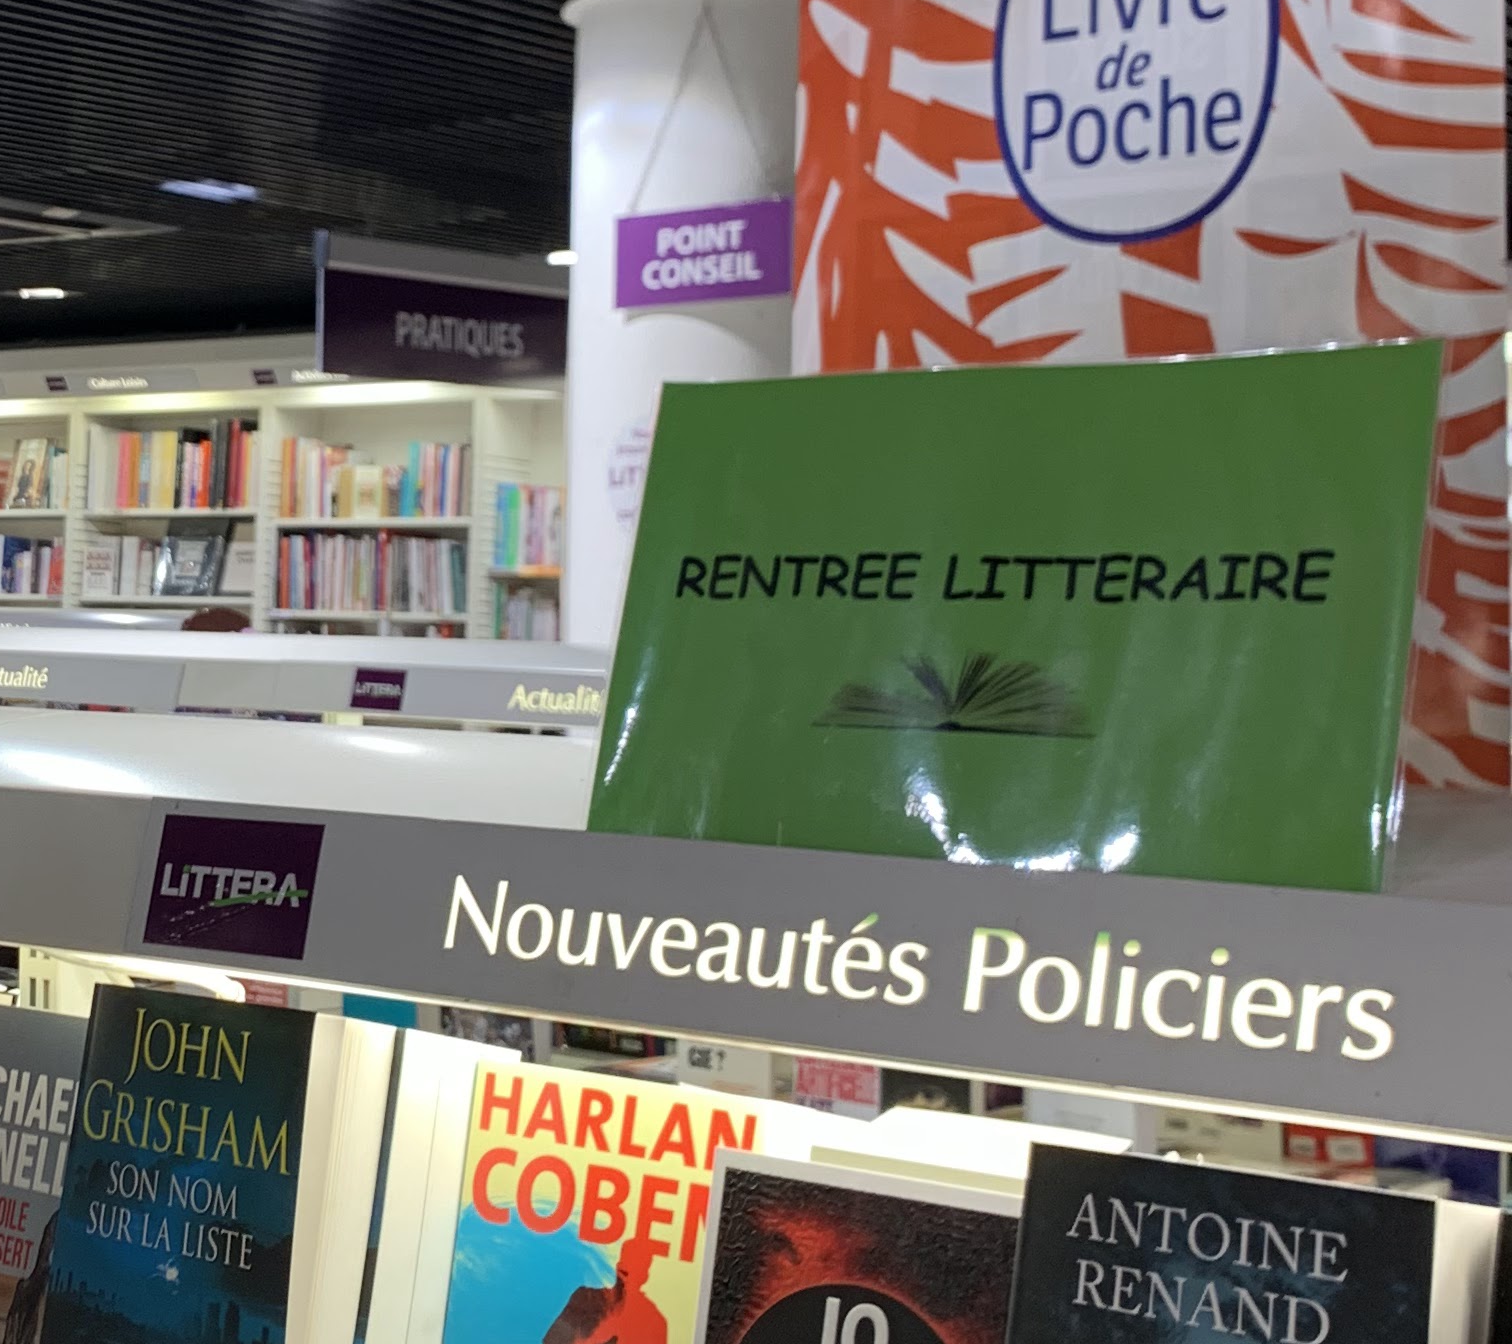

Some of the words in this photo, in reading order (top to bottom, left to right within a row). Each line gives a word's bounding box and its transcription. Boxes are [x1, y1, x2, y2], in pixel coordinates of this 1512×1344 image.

[1094, 45, 1152, 92] de
[1021, 78, 1245, 172] Poche
[641, 249, 762, 291] CONSEIL
[656, 219, 748, 254] POINT
[395, 310, 525, 357] PRATIQUES
[676, 552, 921, 601] RENTREE
[942, 549, 1335, 605] LITTERAIRE
[442, 873, 930, 1013] Nouveautés
[965, 925, 1396, 1058] Policiers
[125, 1006, 251, 1086] JOHN
[80, 1077, 291, 1176] GRISHAM
[477, 1071, 758, 1170] HARLAN
[105, 1160, 159, 1202] SON
[168, 1175, 238, 1220] NOM
[85, 1198, 133, 1240] SUR
[140, 1213, 173, 1252] LA
[181, 1222, 254, 1272] LISTE
[1066, 1191, 1349, 1285] ANTOINE
